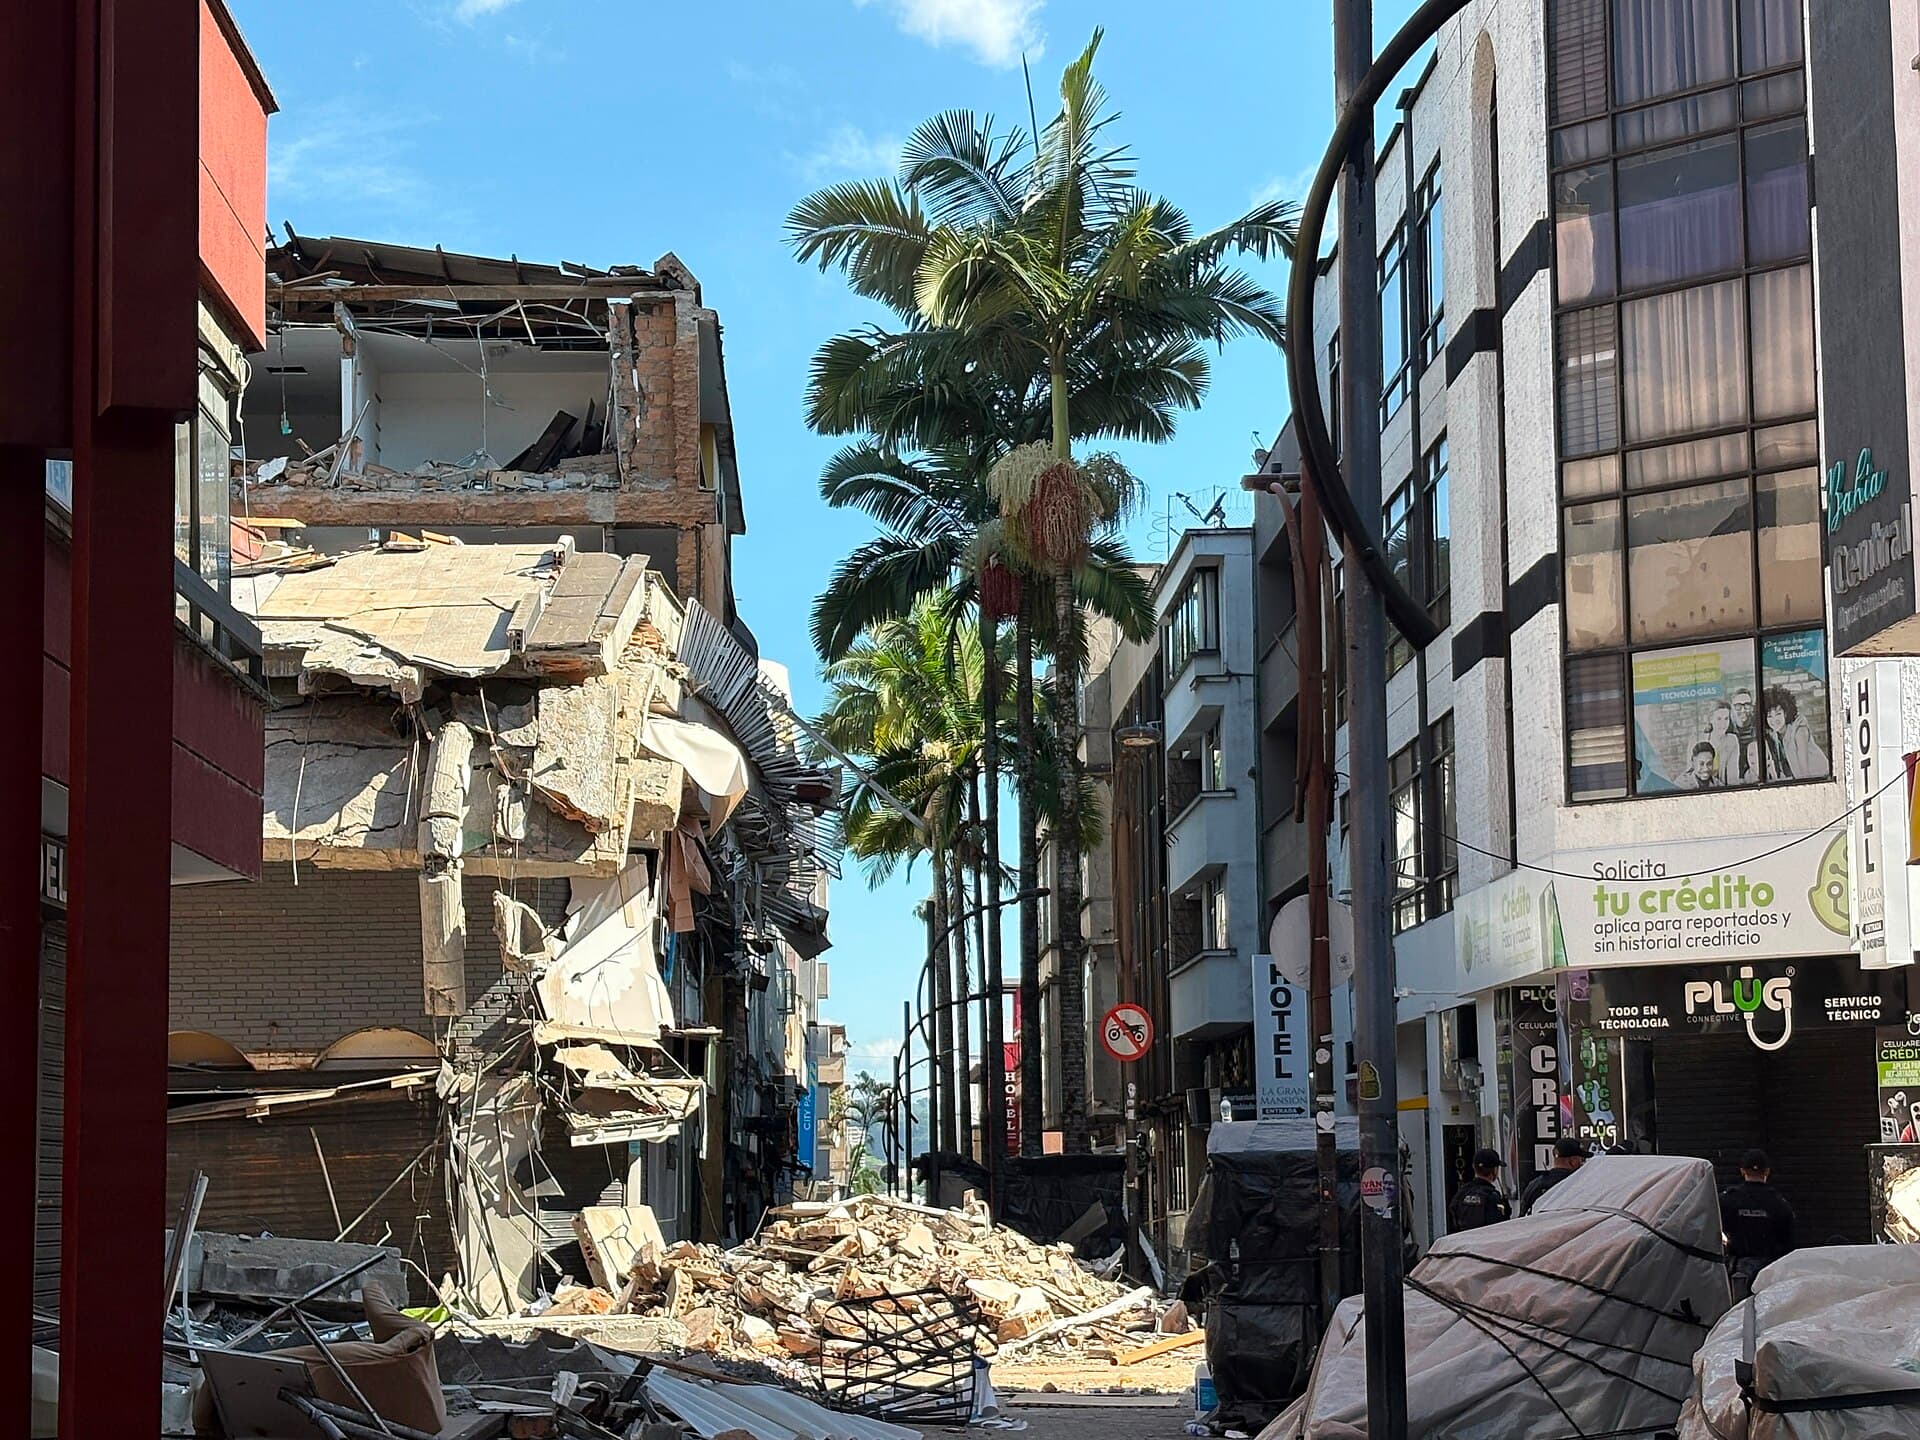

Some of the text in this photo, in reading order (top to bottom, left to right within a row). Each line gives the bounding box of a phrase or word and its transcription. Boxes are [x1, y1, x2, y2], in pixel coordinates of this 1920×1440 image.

[1832, 503, 1912, 594] Central
[1857, 678, 1875, 874] HOTEL
[1592, 859, 1667, 881] Solicita
[1593, 874, 1775, 917] tu crédito
[1594, 911, 1791, 938] aplica para reportados y
[1594, 930, 1761, 953] sin historial crediticio
[1519, 987, 1557, 1004] PLUG
[1685, 967, 1792, 1020] PLUG
[1824, 995, 1882, 1009] SERVICIO
[1608, 1005, 1658, 1017] TODO EN
[1826, 1008, 1881, 1021] TÉCNICO
[1883, 1040, 1920, 1048] CELULARE
[1004, 1071, 1016, 1130] HOTEL
[1276, 1086, 1306, 1095] GRAN
[803, 1108, 812, 1131] CITY
[1530, 1045, 1557, 1171] CRÉD
[1580, 1122, 1616, 1141] PLUG
